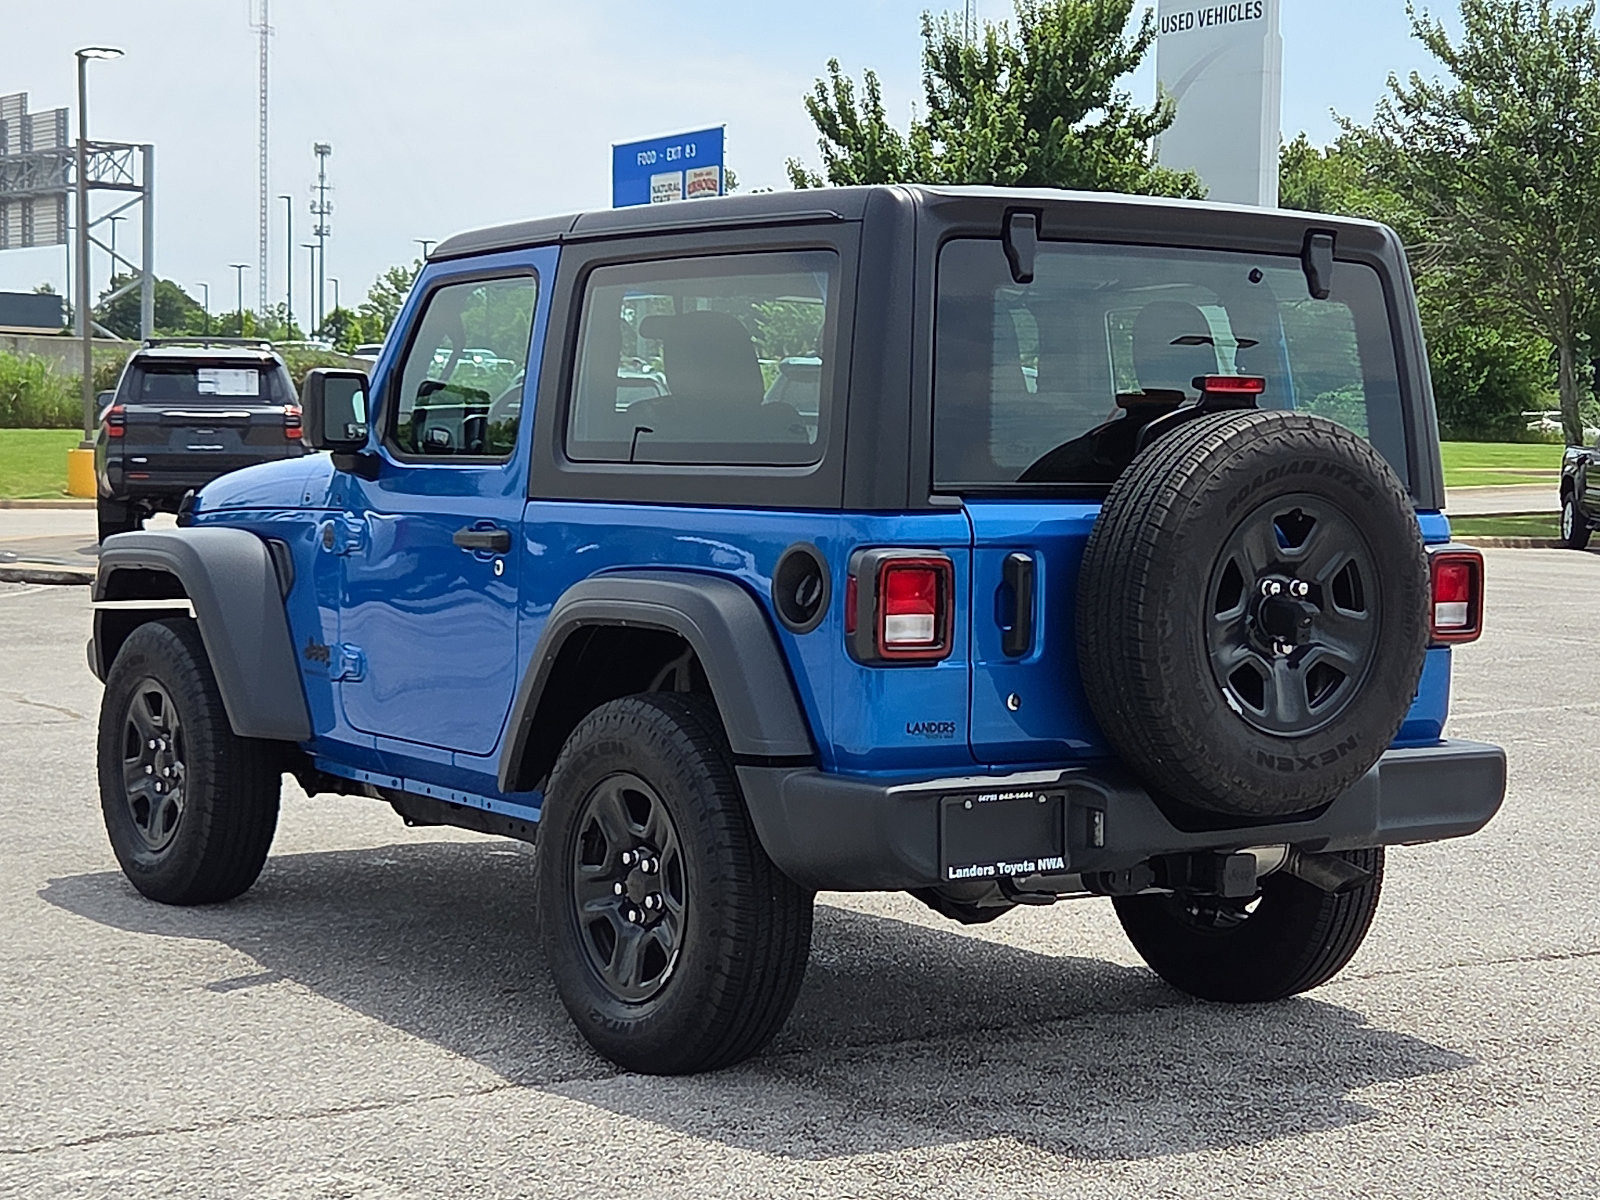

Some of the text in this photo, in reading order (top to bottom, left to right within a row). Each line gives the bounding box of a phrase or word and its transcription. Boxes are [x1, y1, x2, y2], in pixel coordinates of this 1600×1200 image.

[1161, 0, 1263, 34] USED VEHICLES
[637, 150, 657, 166] FOOD
[906, 720, 956, 735] LANDERS
[1256, 734, 1358, 772] NEXEN
[948, 856, 1065, 879] Landers Toyota NWA
